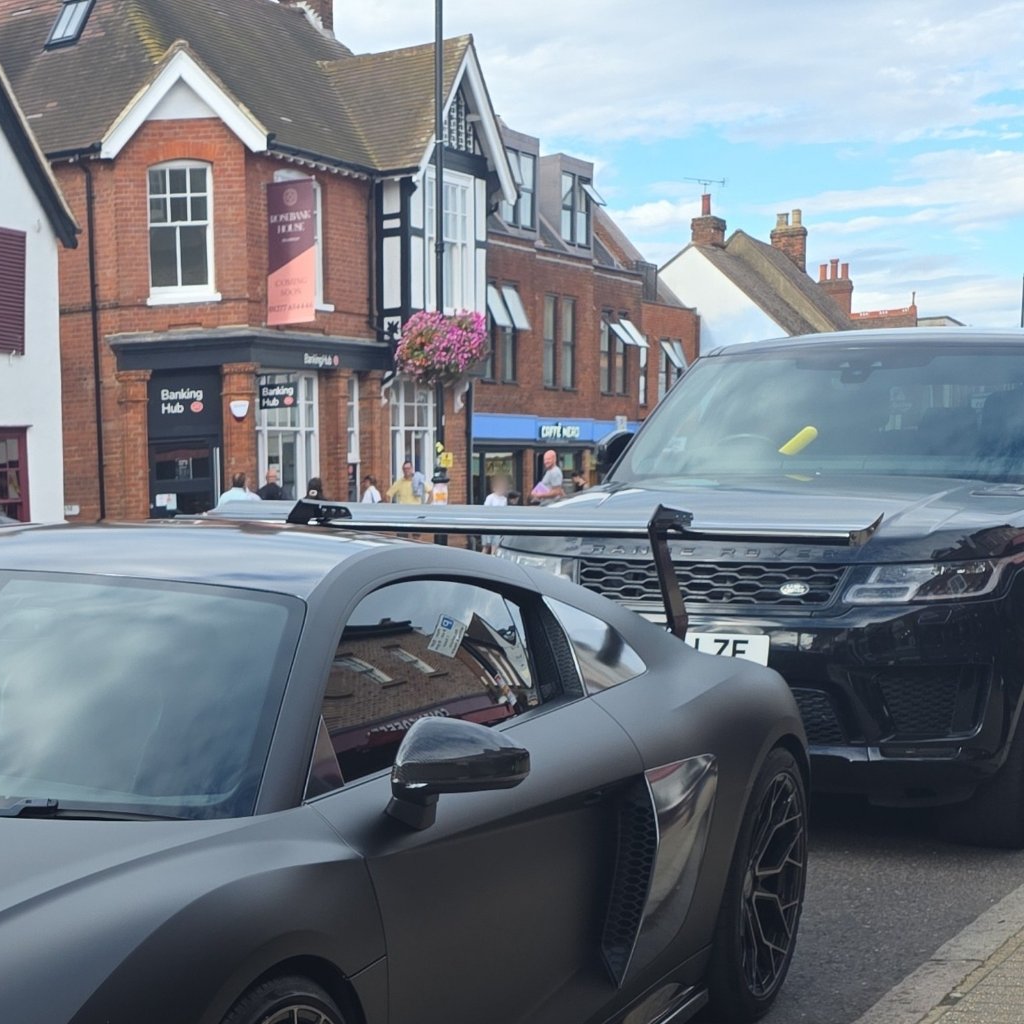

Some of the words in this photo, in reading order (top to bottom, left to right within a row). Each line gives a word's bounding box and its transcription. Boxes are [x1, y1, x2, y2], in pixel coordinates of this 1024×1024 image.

[277, 222, 305, 234] HOUSE
[161, 388, 203, 401] Banking
[262, 386, 294, 398] Banking
[161, 402, 184, 414] Hub
[262, 399, 280, 407] Hub
[591, 544, 696, 557] RANE
[720, 547, 840, 560] ROVER
